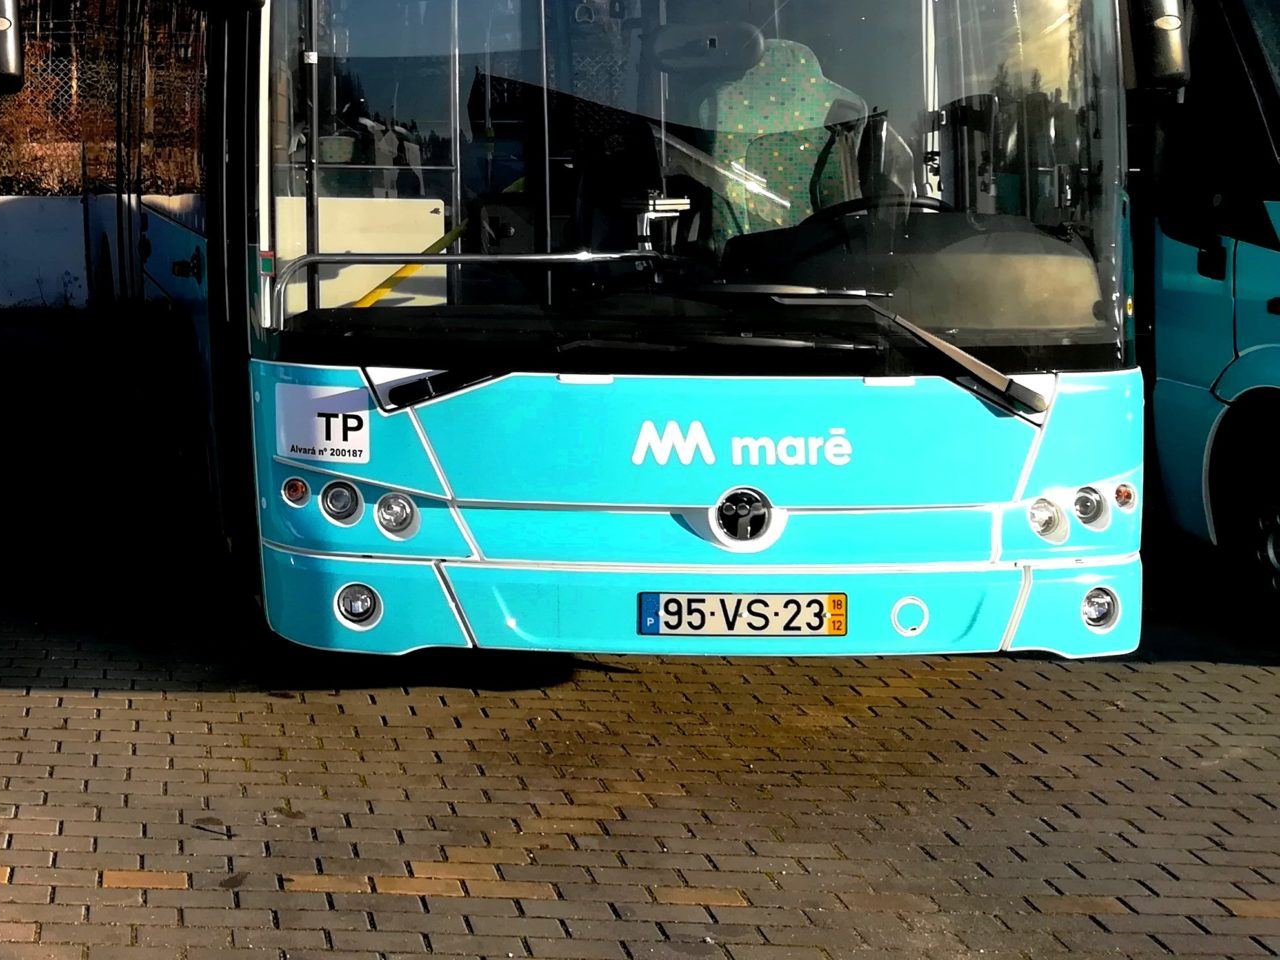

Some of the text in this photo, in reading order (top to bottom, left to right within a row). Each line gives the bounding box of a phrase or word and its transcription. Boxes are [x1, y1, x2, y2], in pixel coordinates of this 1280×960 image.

[317, 412, 364, 442] TP
[290, 444, 317, 456] Alvará
[330, 448, 364, 458] 200187
[832, 599, 843, 610] 18
[647, 617, 654, 627] P
[832, 620, 843, 631] 12
